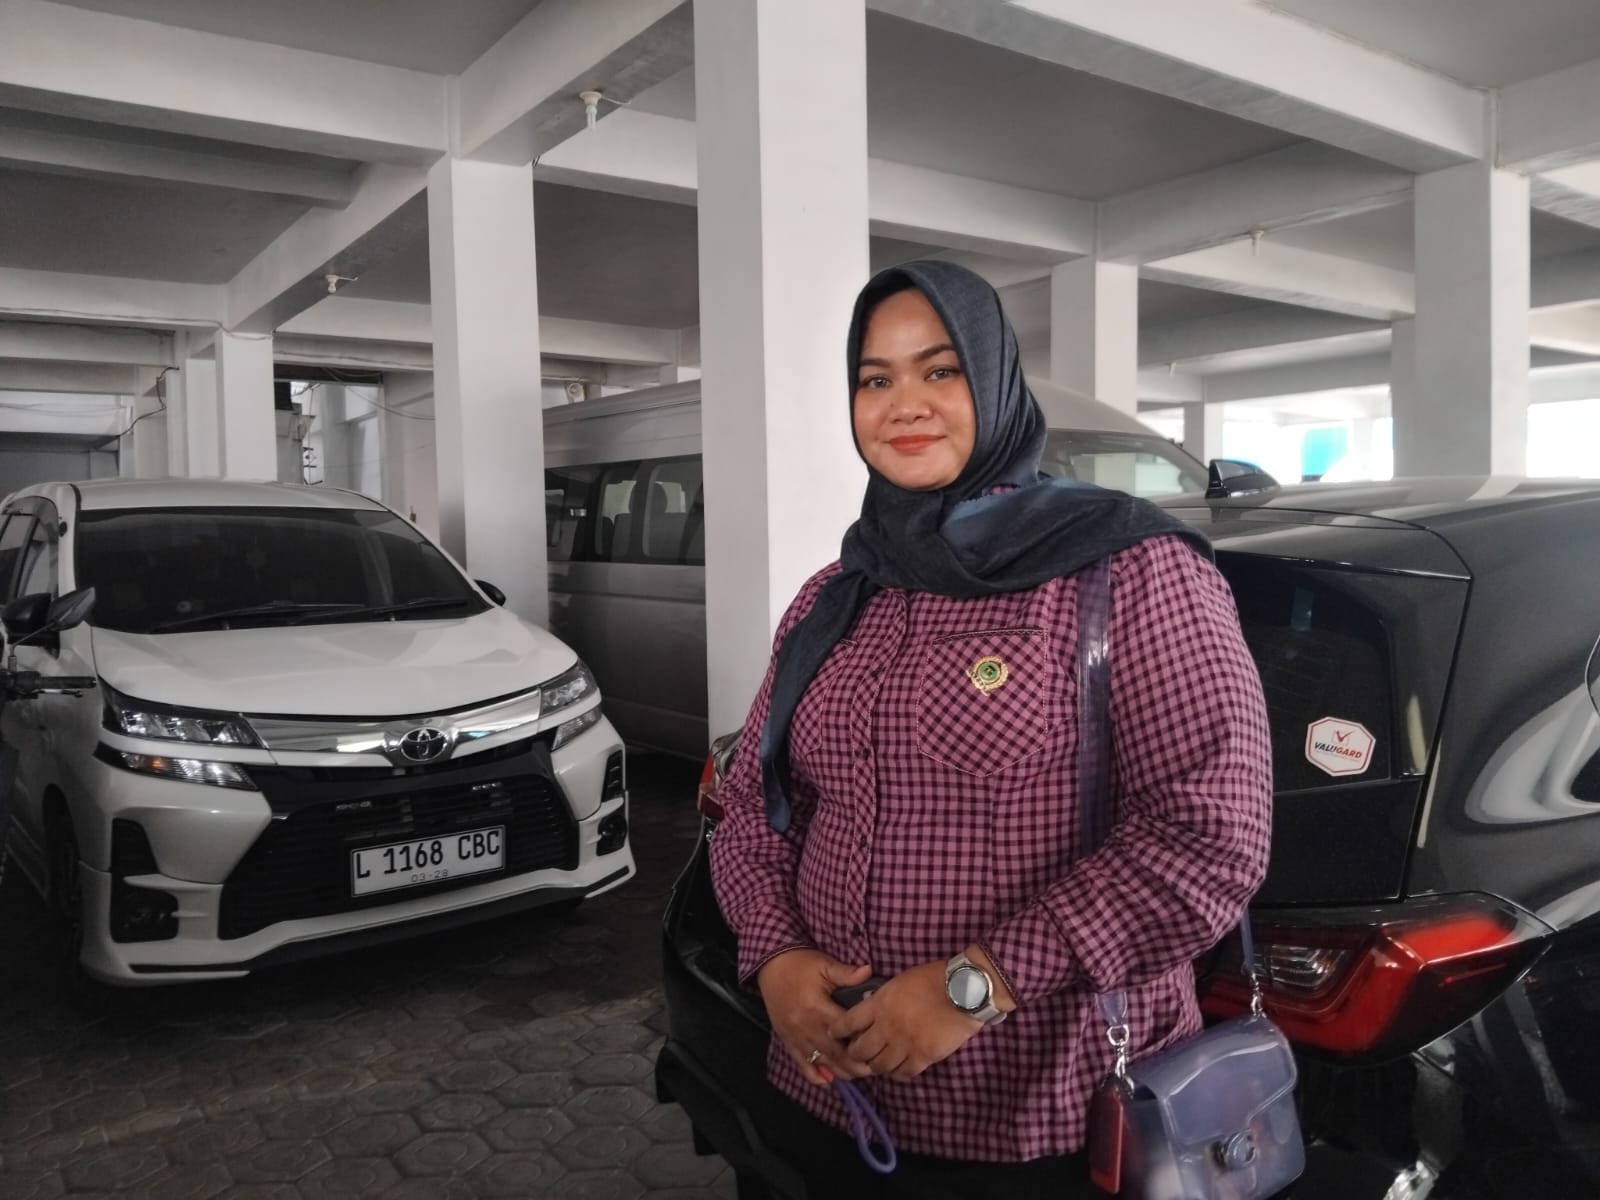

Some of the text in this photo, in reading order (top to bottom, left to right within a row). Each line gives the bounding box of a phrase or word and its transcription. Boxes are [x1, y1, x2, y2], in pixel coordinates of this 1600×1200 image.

[356, 830, 500, 879] L 1168 CBC
